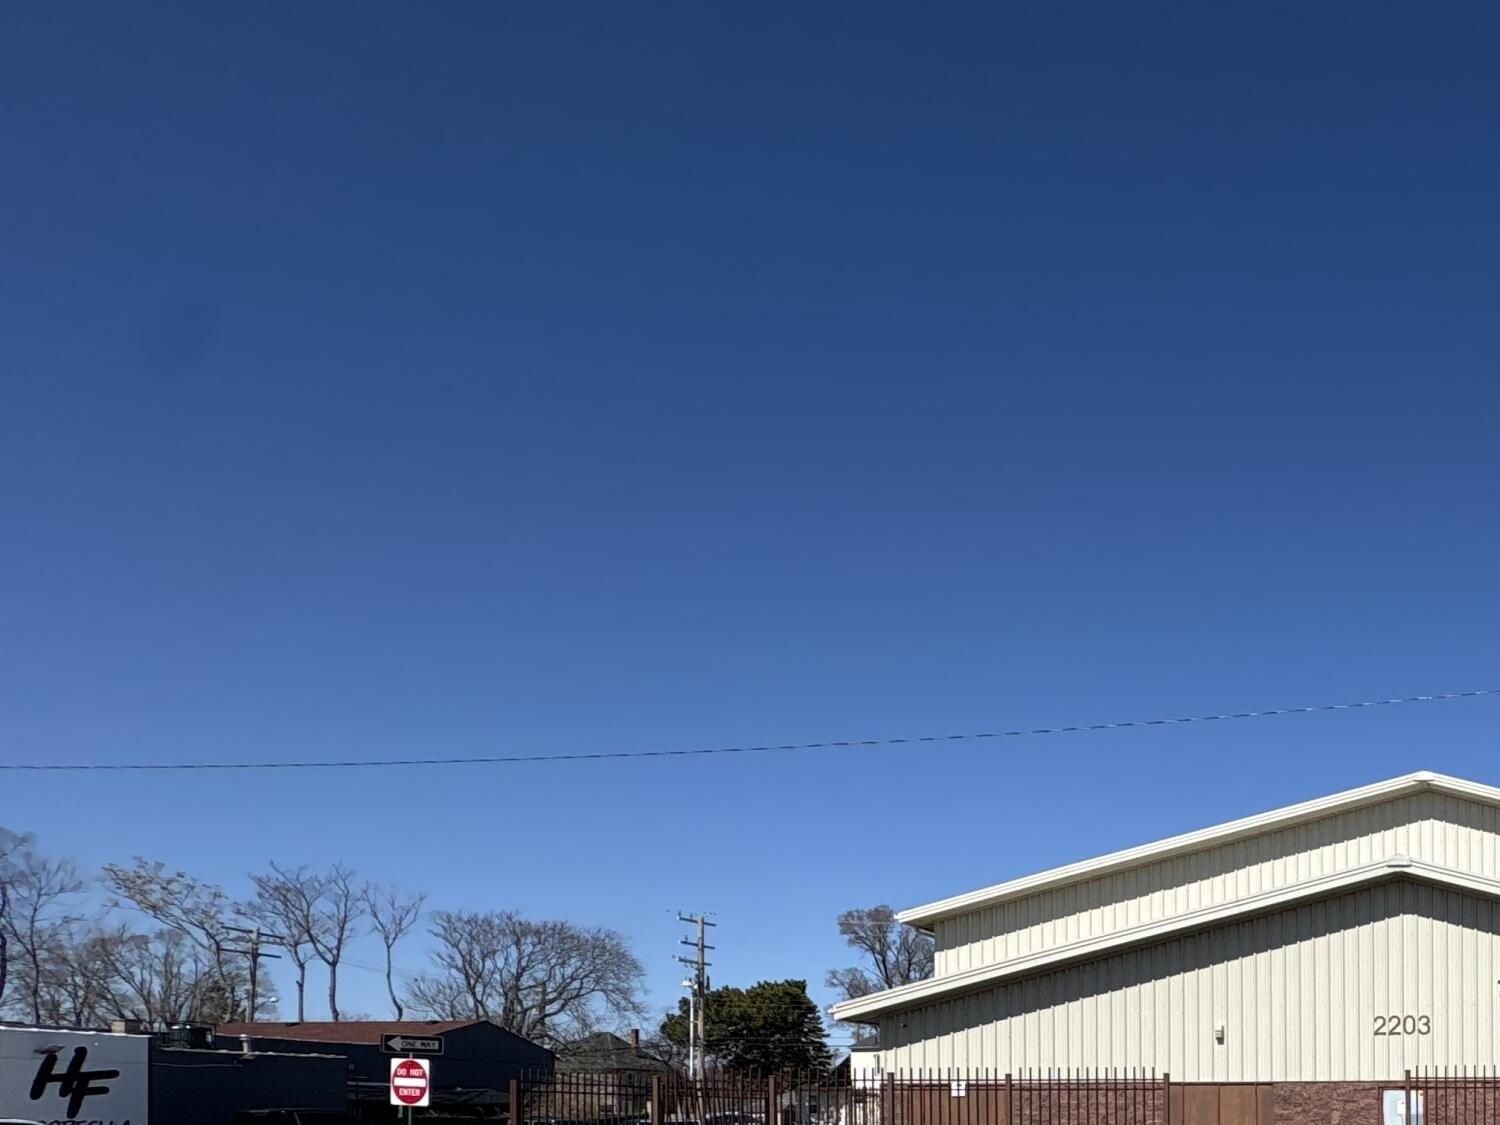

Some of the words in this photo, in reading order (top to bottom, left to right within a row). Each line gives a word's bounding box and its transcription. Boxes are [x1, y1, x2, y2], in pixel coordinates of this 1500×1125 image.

[1373, 1015, 1431, 1036] 2203
[401, 1040, 417, 1048] ONE
[420, 1041, 437, 1049] WAY
[396, 1068, 407, 1076] DO
[29, 1046, 120, 1119] HF
[399, 1088, 421, 1097] ENTER
